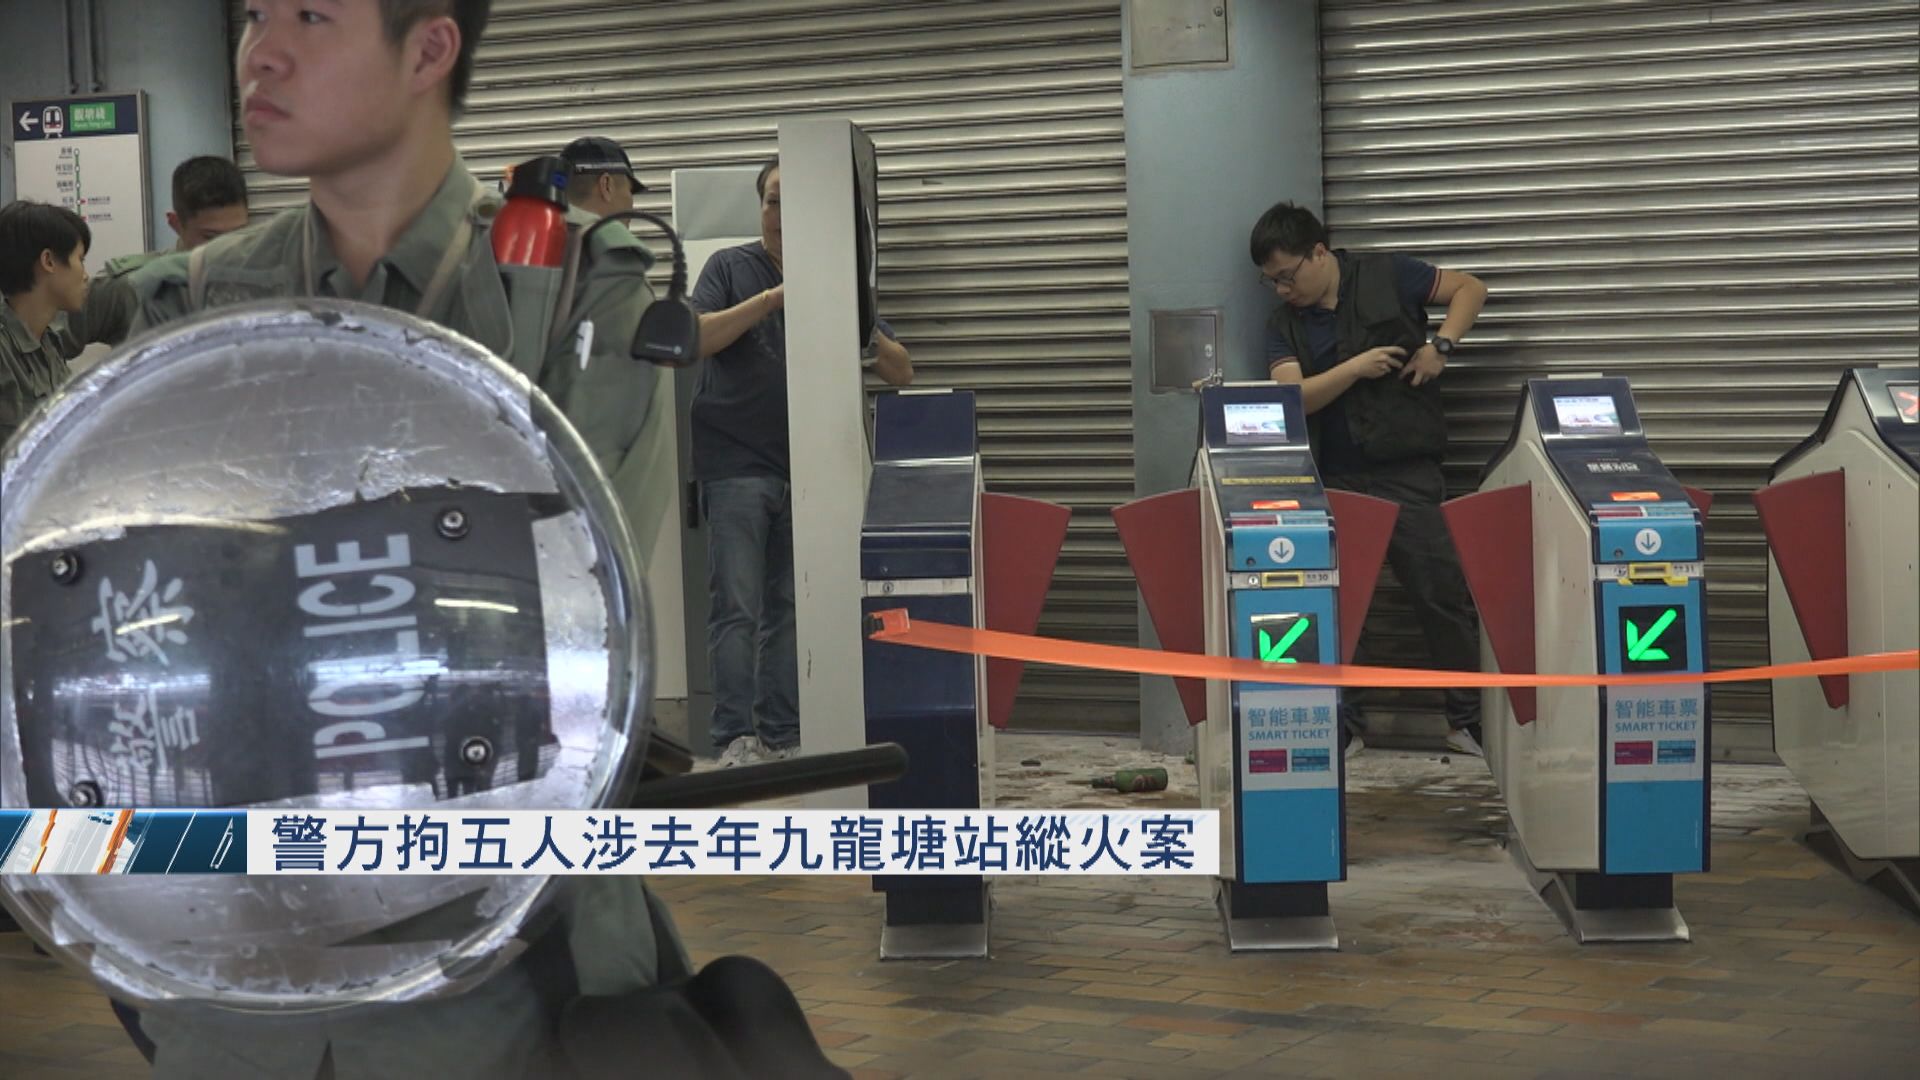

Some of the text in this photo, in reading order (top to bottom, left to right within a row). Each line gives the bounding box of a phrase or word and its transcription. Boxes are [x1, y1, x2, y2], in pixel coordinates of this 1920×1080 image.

[294, 532, 430, 760] POLICE
[1247, 706, 1332, 728] 智能車票
[1615, 698, 1698, 719] 智能車票
[1248, 728, 1332, 741] SMART TICKET
[1615, 720, 1698, 733] SMART TICKET
